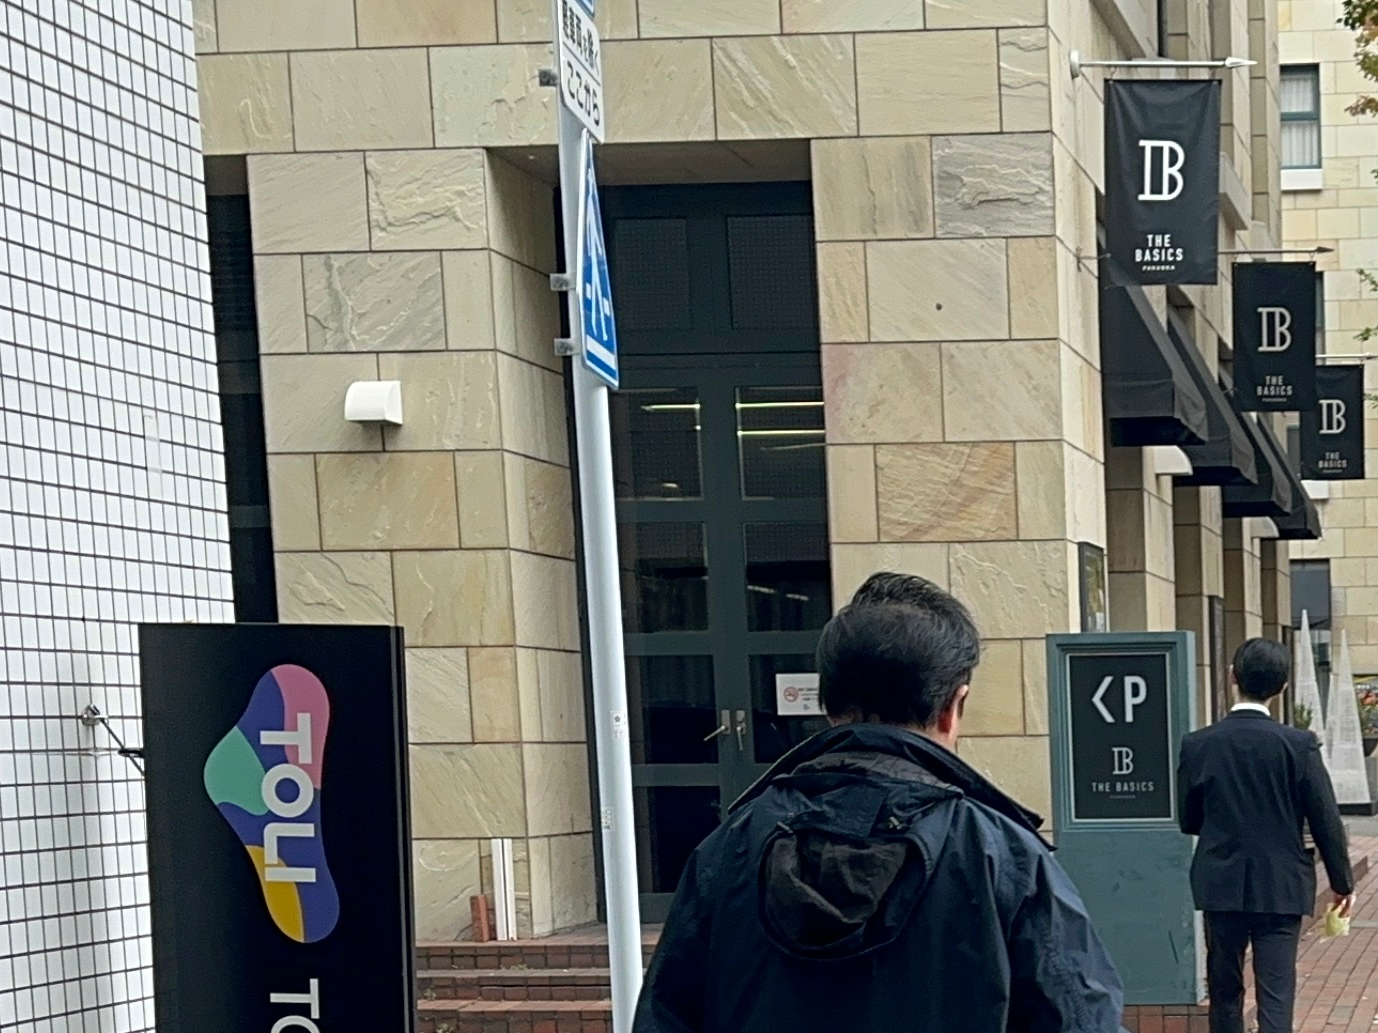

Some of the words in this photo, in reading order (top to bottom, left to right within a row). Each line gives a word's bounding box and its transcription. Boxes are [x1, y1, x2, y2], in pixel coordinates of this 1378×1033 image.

[567, 60, 600, 127] ここから
[1146, 234, 1171, 247] THE
[1134, 248, 1184, 262] BASICS
[1265, 375, 1284, 385] THE
[1256, 385, 1293, 396] BASICS
[1092, 782, 1110, 792] THE
[1115, 781, 1154, 792] BASICS
[260, 712, 316, 883] TOLI
